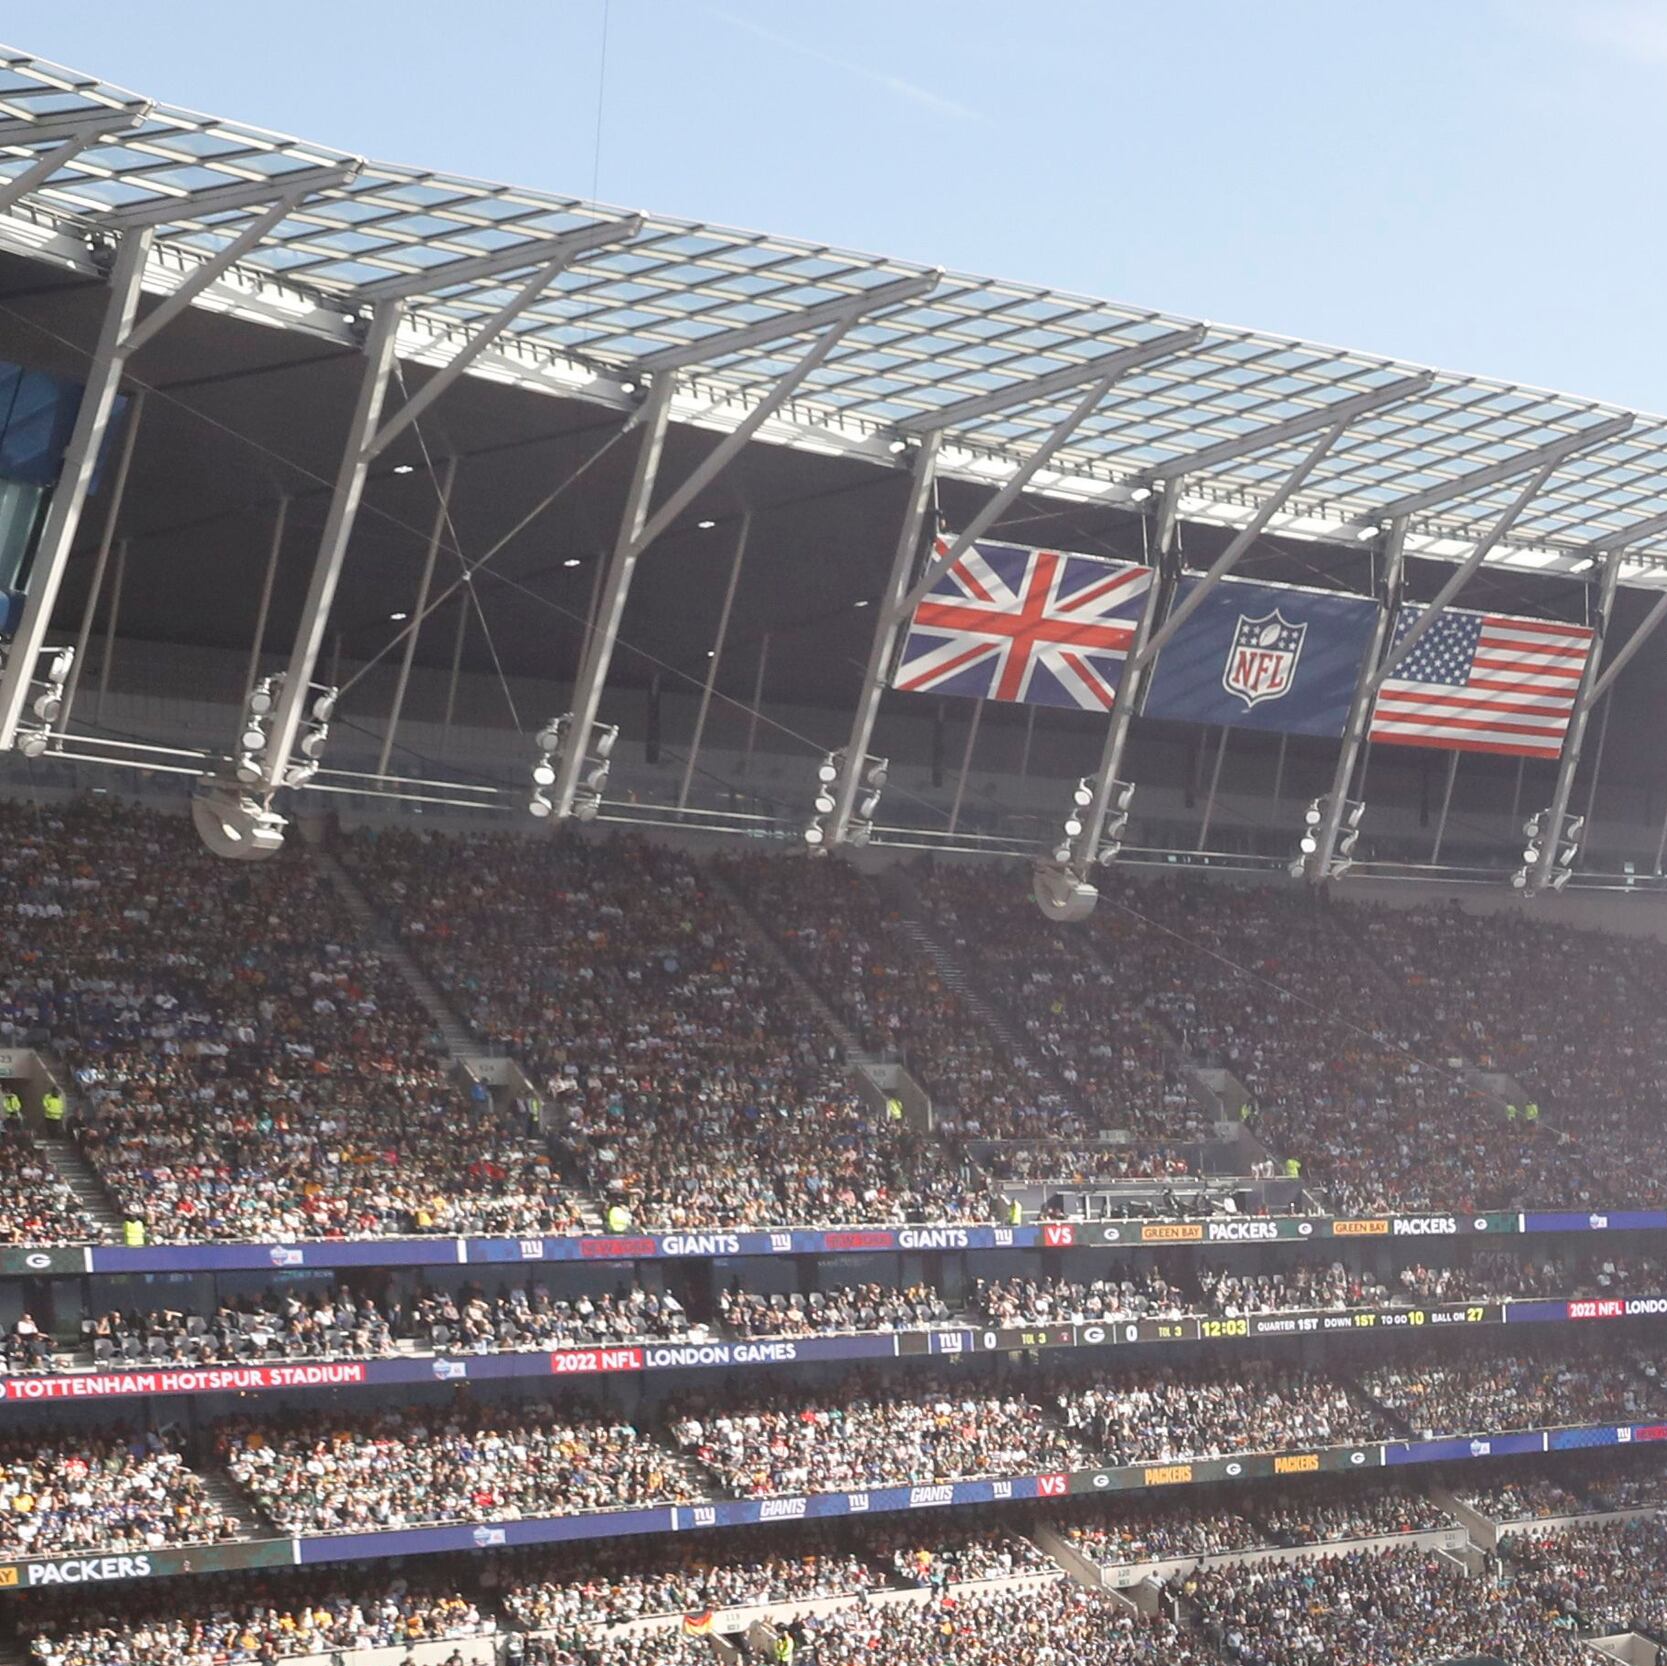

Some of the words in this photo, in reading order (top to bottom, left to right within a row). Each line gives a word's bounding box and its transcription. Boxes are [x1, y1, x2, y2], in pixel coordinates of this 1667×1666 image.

[1231, 646, 1289, 692] NFL
[1144, 1227, 1178, 1238] GREEN
[1182, 1226, 1200, 1237] BAY
[1208, 1222, 1278, 1240] PACKERS
[1335, 1222, 1367, 1233] GREEN
[1368, 1221, 1387, 1232] BAY
[1393, 1214, 1457, 1235] PACKERS
[662, 1235, 740, 1254] GIANTS
[899, 1229, 968, 1248] GIANTS
[1047, 1227, 1072, 1244] VS
[1570, 1303, 1596, 1318] 2022
[1599, 1301, 1623, 1316] NFL
[1202, 1319, 1247, 1338] 12:03
[1257, 1320, 1295, 1332] QUARTER
[1297, 1318, 1319, 1330] 1ST
[1324, 1317, 1352, 1328] DOWN
[1354, 1314, 1375, 1327] 1ST
[1381, 1315, 1393, 1326] TO
[1394, 1315, 1408, 1325] GO
[1408, 1311, 1425, 1326] 10
[1432, 1312, 1451, 1324] BALL
[1453, 1311, 1465, 1323] ON
[1467, 1307, 1484, 1323] 27
[984, 1332, 997, 1349] 0
[1039, 1332, 1047, 1345] 3
[1125, 1325, 1138, 1342] 0
[1174, 1326, 1182, 1337] 3
[555, 1353, 597, 1371] 2022
[602, 1351, 640, 1369] NFL
[646, 1348, 730, 1367] LONDON
[734, 1343, 797, 1362] GAMES
[11, 1374, 156, 1398] TOTTENHAM
[162, 1368, 264, 1393] HOTSPUR
[269, 1364, 361, 1386] STADIUM
[1274, 1454, 1319, 1474] PACKERS
[1040, 1476, 1066, 1493] VS
[1144, 1464, 1192, 1486] PACKERS
[910, 1484, 954, 1505] GIANTS
[759, 1497, 807, 1521] GIANTS
[28, 1554, 152, 1585] PACKERS
